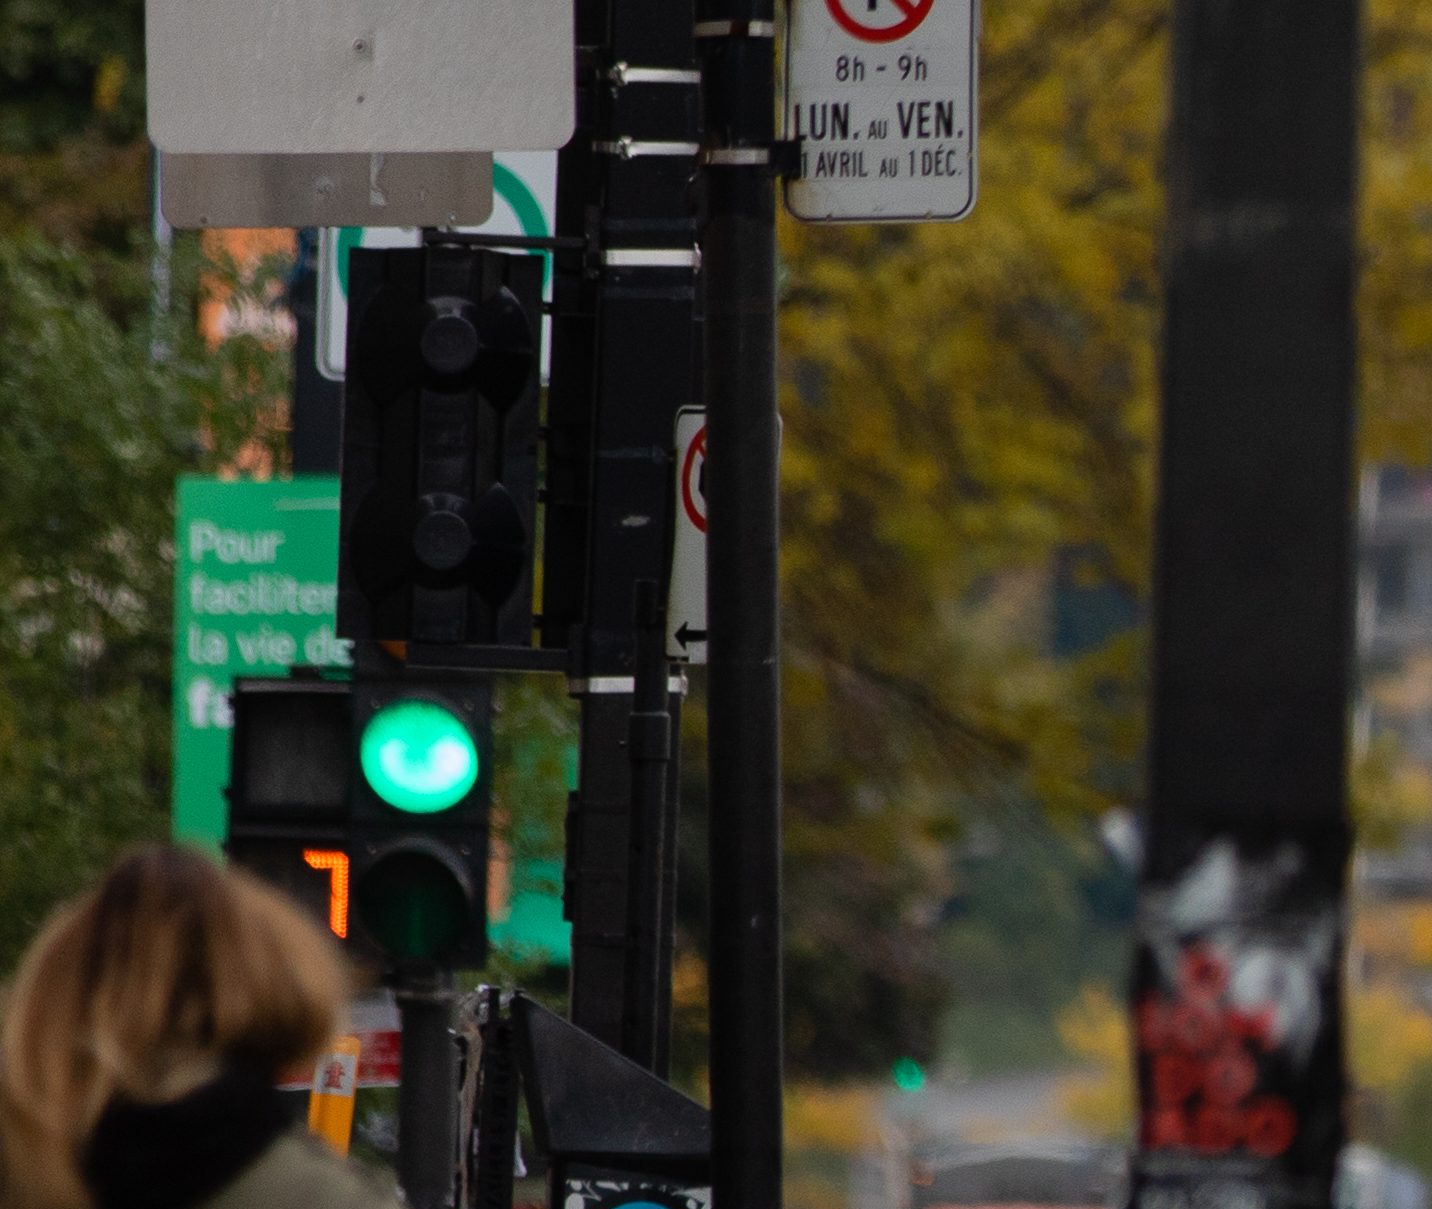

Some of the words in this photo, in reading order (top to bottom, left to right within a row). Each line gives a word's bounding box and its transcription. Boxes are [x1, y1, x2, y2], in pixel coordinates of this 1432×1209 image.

[835, 55, 865, 82] 8h
[898, 54, 928, 82] 9h
[793, 102, 860, 141] LUN.
[867, 119, 889, 140] AU
[896, 101, 964, 140] VEN.
[815, 151, 869, 178] AVRIL
[879, 158, 899, 178] AU
[909, 151, 915, 178] 1
[921, 144, 963, 177] DÉC.
[190, 518, 286, 564] Pour
[189, 622, 230, 667] la
[235, 624, 298, 666] vie
